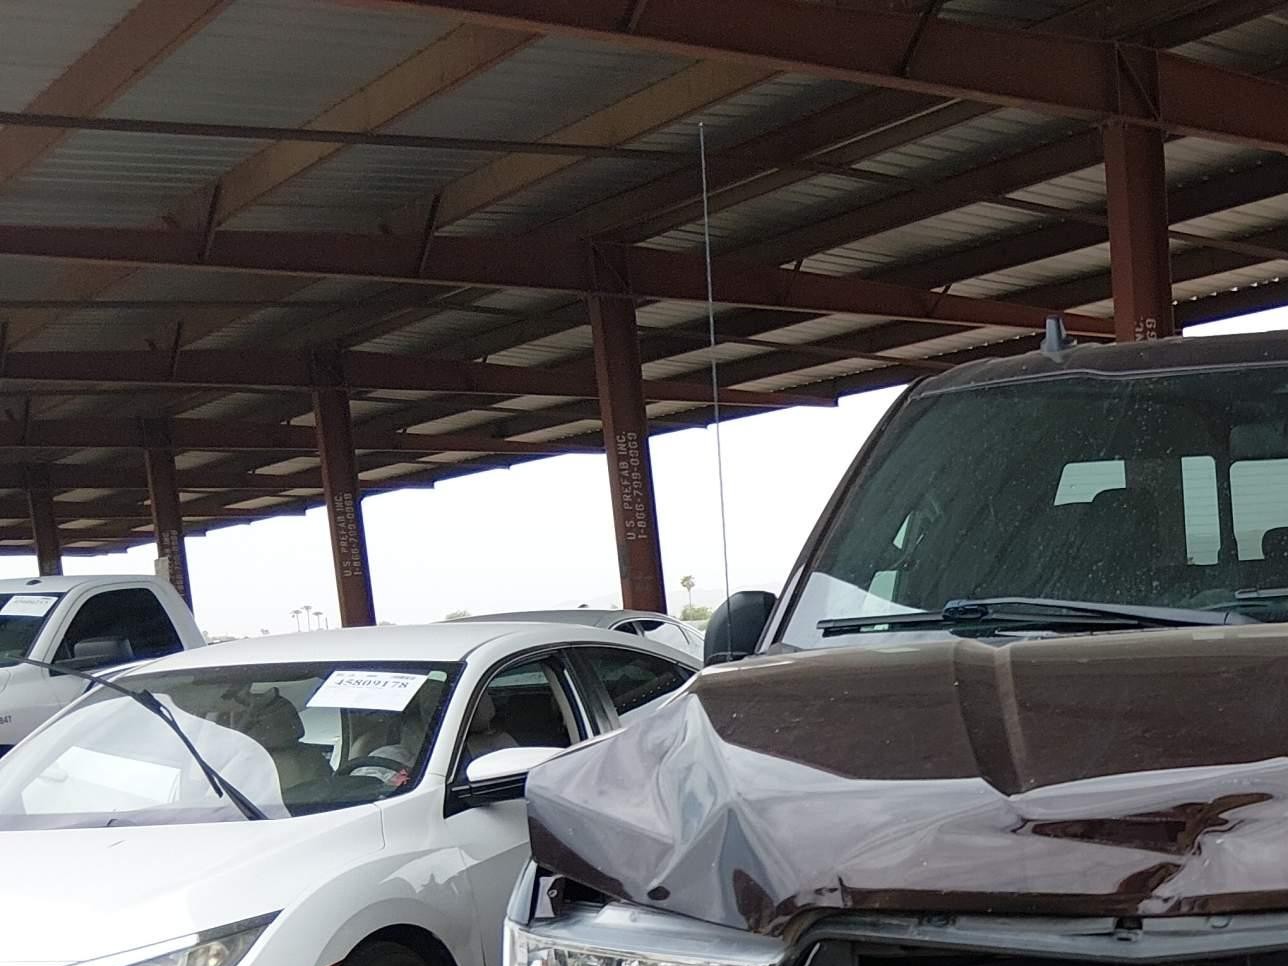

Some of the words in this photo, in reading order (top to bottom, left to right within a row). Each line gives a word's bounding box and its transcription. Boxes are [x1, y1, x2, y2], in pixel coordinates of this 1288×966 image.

[616, 431, 628, 455] INC.
[619, 461, 633, 510] PREFAB
[335, 678, 409, 689] 45809178
